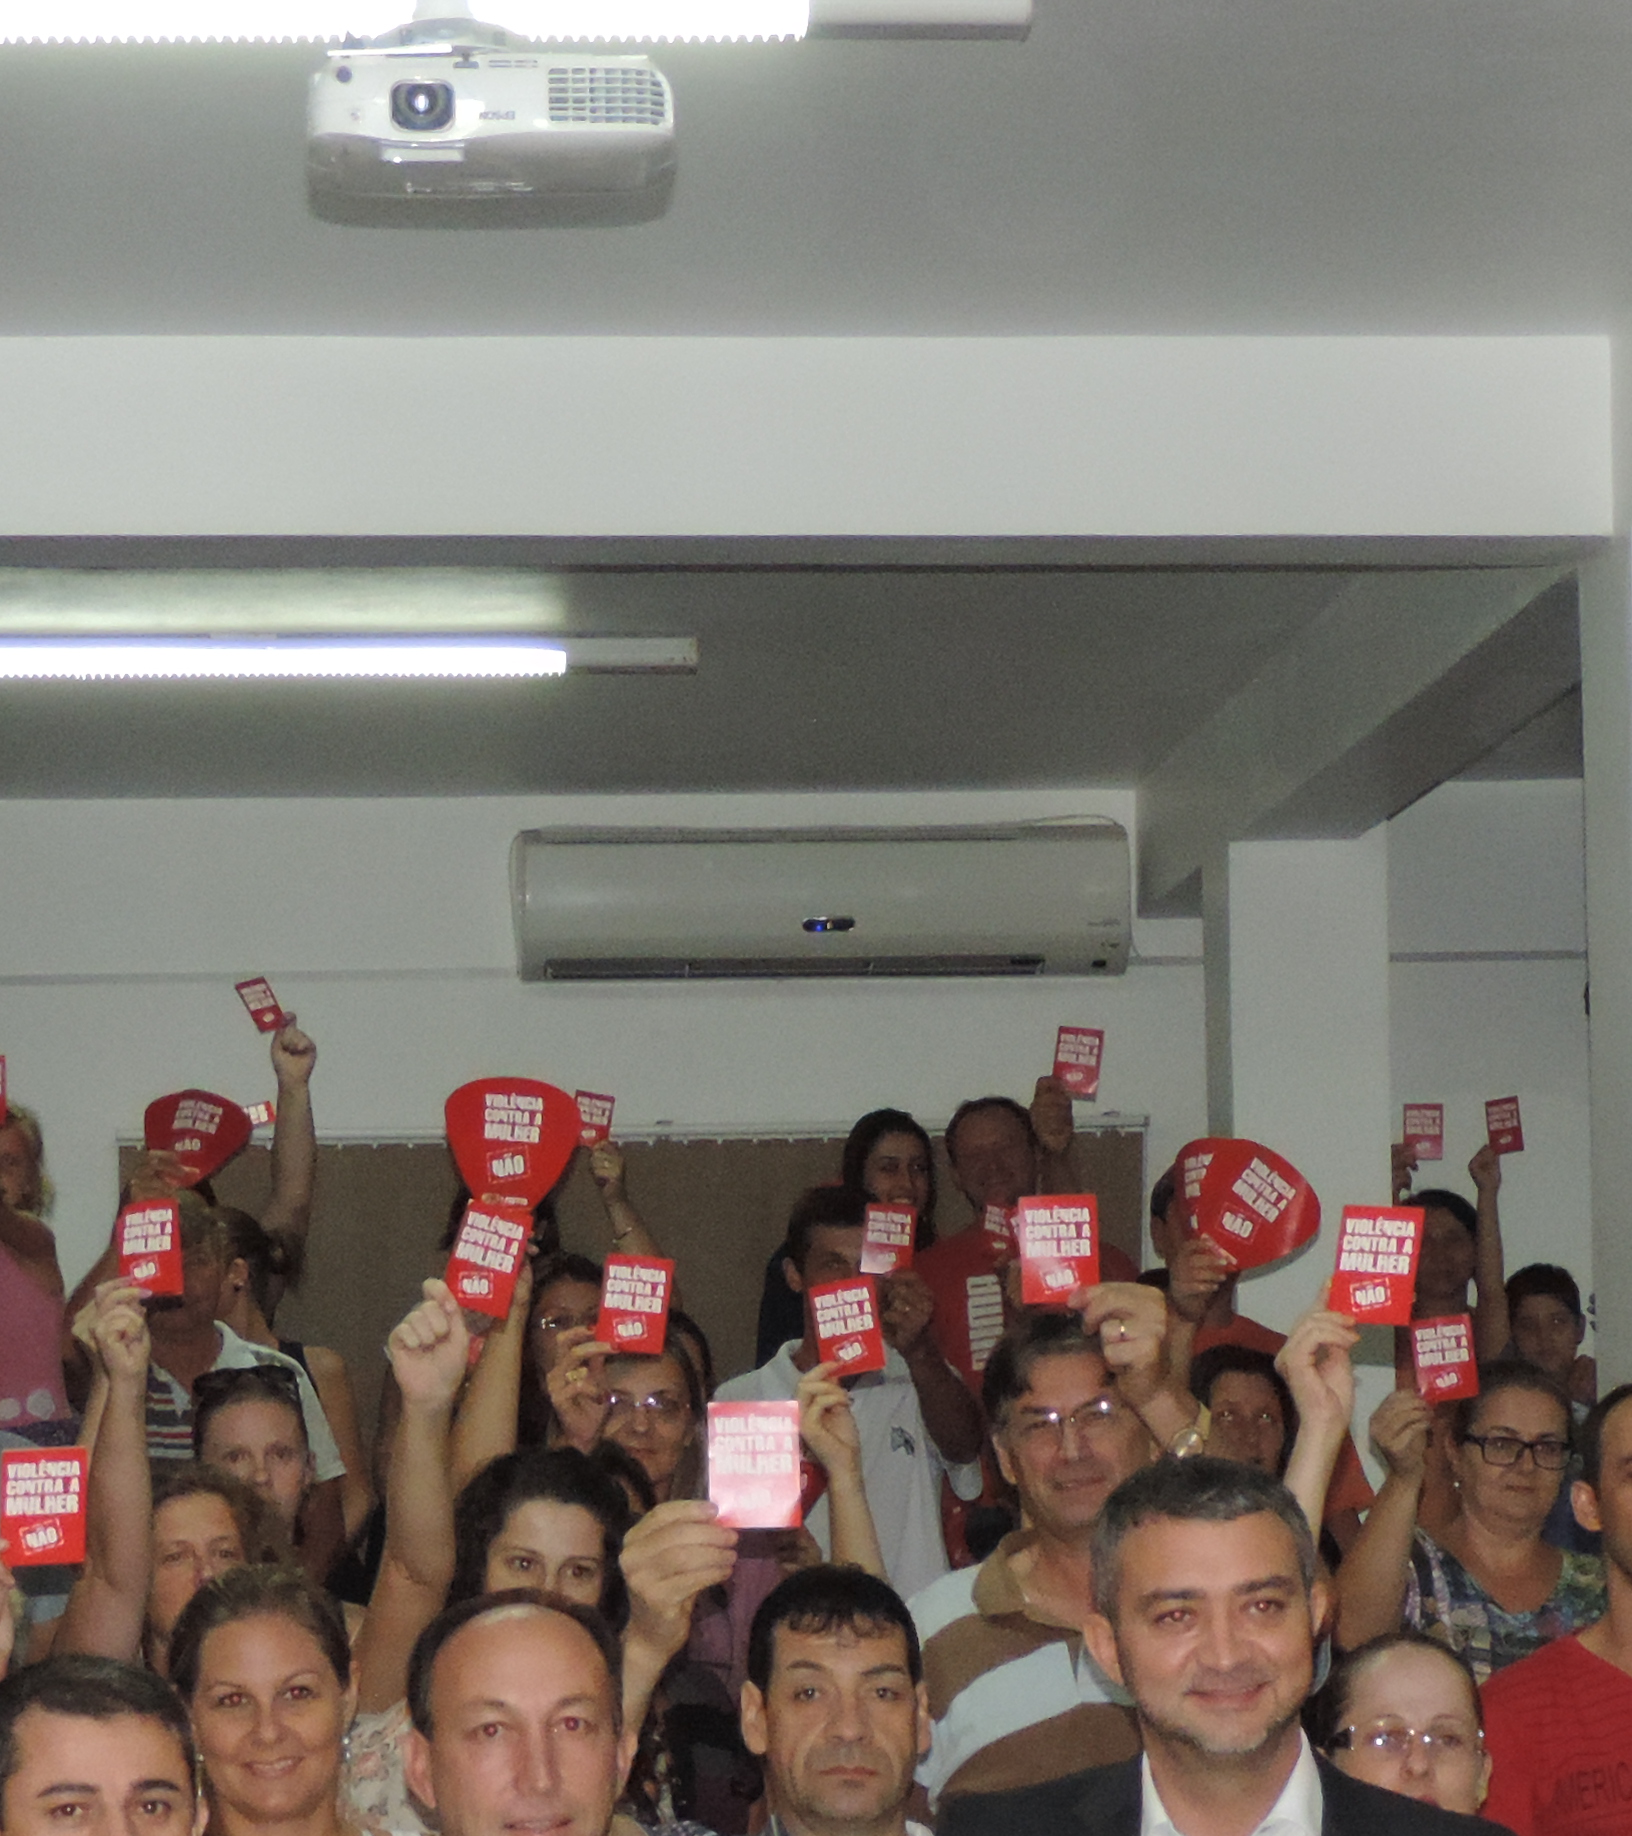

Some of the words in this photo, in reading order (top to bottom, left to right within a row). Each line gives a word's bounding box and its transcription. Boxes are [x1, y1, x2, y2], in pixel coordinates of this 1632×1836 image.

[485, 1094, 542, 1110] VIOLÊNCIA
[485, 1108, 529, 1124] CONTRA
[484, 1122, 539, 1142] MULHER
[1241, 1169, 1278, 1203] CONTRA
[1250, 1157, 1296, 1200] VIOLÊNCIA
[1232, 1179, 1279, 1223] MULHER
[1020, 1206, 1089, 1224] VIOLÊNCIA
[467, 1212, 523, 1239] VIOLÊNCIA
[1020, 1223, 1076, 1239] CONTRA
[1346, 1217, 1414, 1236] VIOLÊNCIA
[463, 1226, 505, 1251] CONTRA
[1021, 1238, 1090, 1258] MULHER
[1343, 1234, 1396, 1253] CONTRA
[456, 1241, 513, 1273] MULHER
[1340, 1250, 1409, 1273] MULHER
[609, 1265, 665, 1283] VIOLÊNCIA
[606, 1278, 651, 1296] CONTRA
[604, 1292, 661, 1312] MULHER
[814, 1287, 868, 1309] VIOLÊNCIA
[816, 1302, 859, 1323] CONTRA
[819, 1314, 873, 1338] MULHER
[7, 1460, 79, 1479] VIOLÊNCIA
[6, 1478, 63, 1496] CONTRA
[6, 1494, 78, 1515] MULHER
